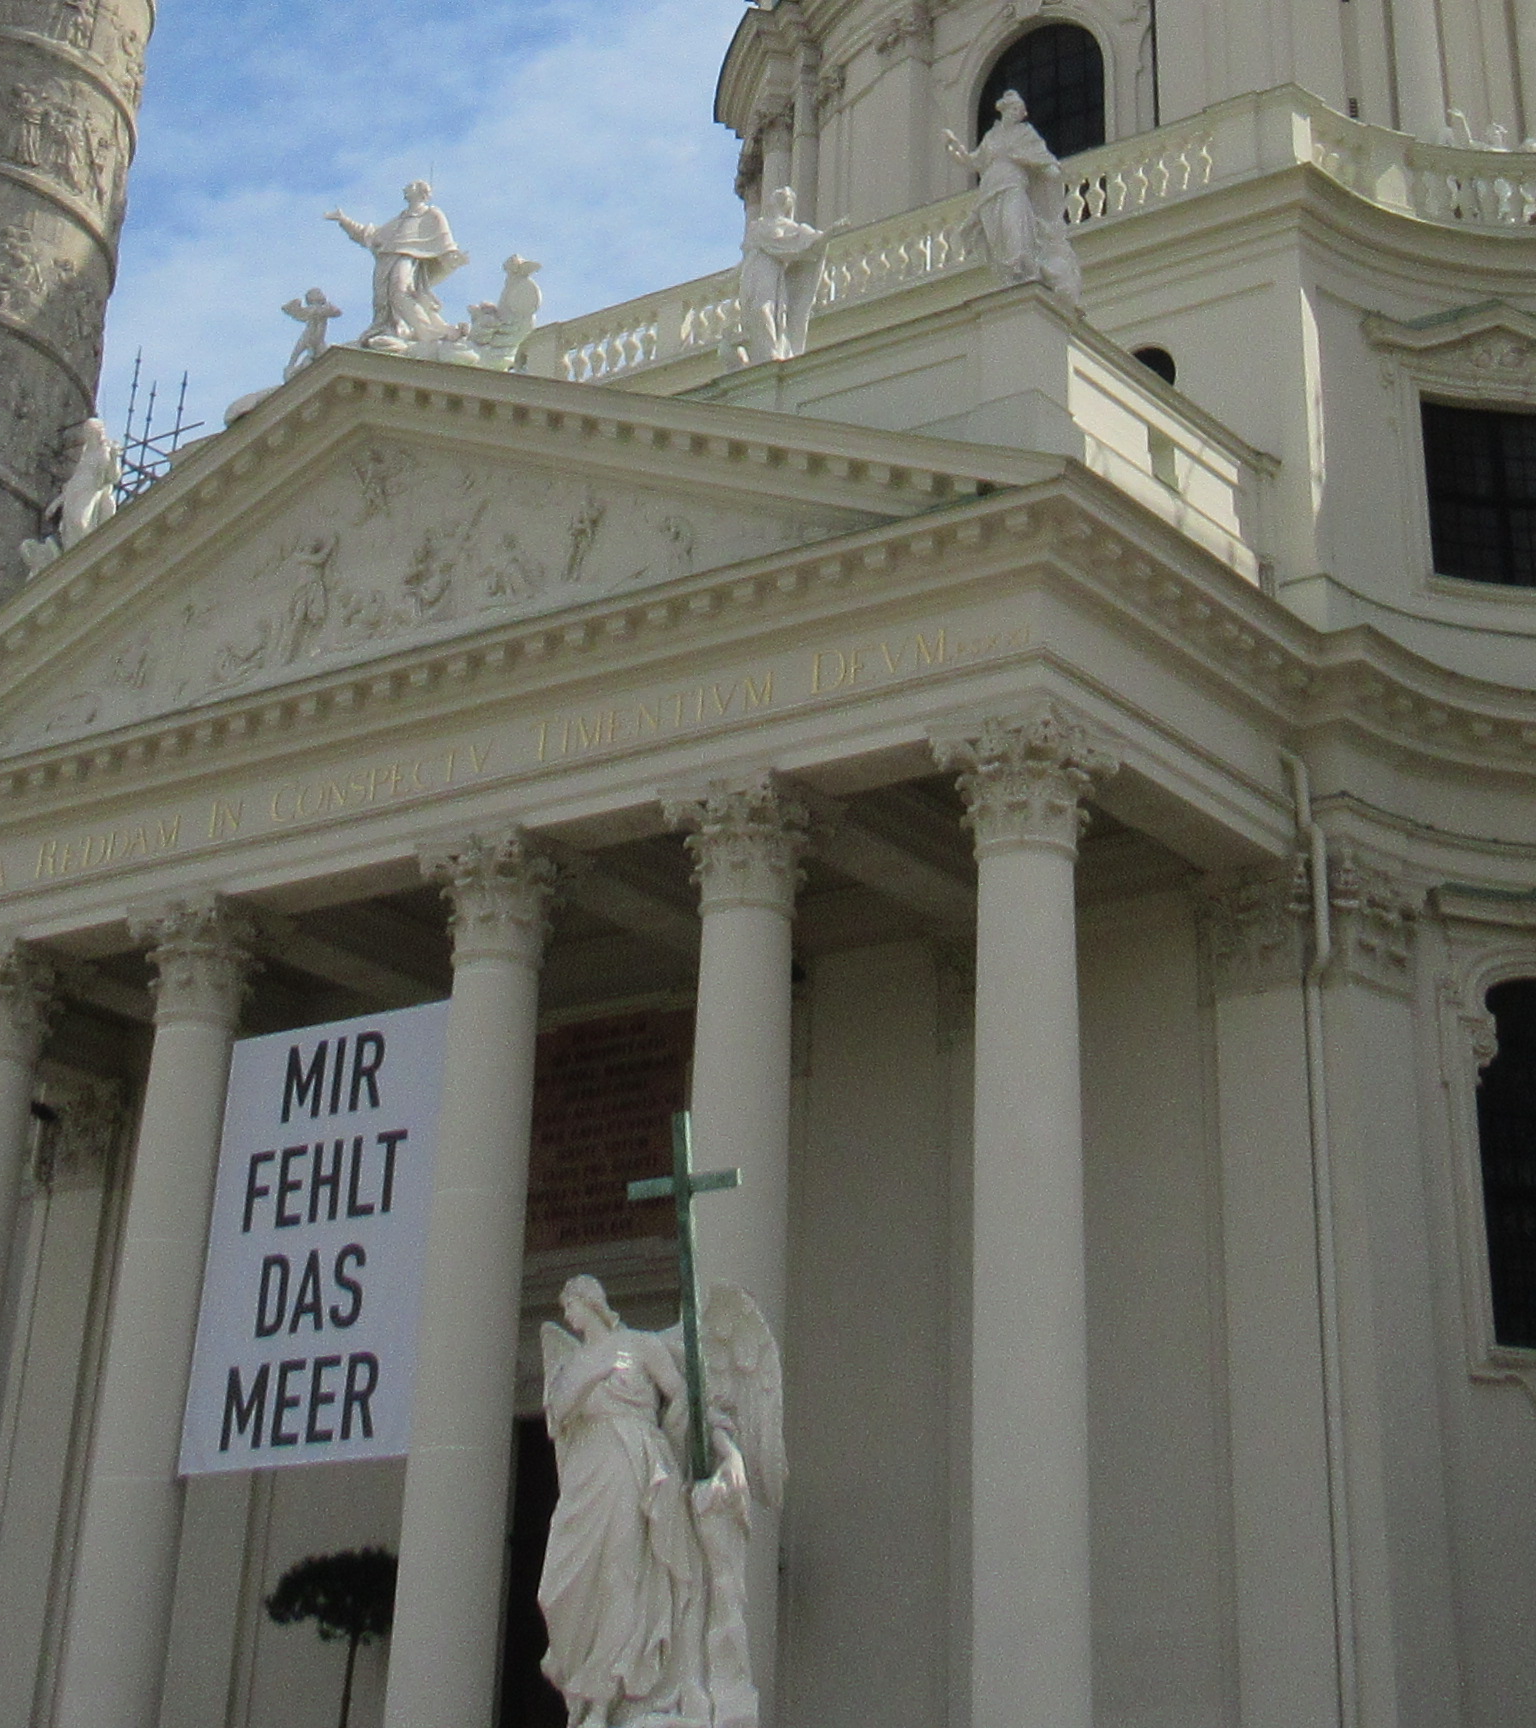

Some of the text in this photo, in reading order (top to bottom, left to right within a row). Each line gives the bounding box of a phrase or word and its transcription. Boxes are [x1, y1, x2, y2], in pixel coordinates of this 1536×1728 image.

[35, 813, 182, 879] REDDAM
[208, 797, 244, 839] IN
[280, 1030, 386, 1124] MIR
[241, 1129, 409, 1234] FEHLT
[254, 1243, 367, 1339] DAS
[218, 1351, 380, 1453] MEER
